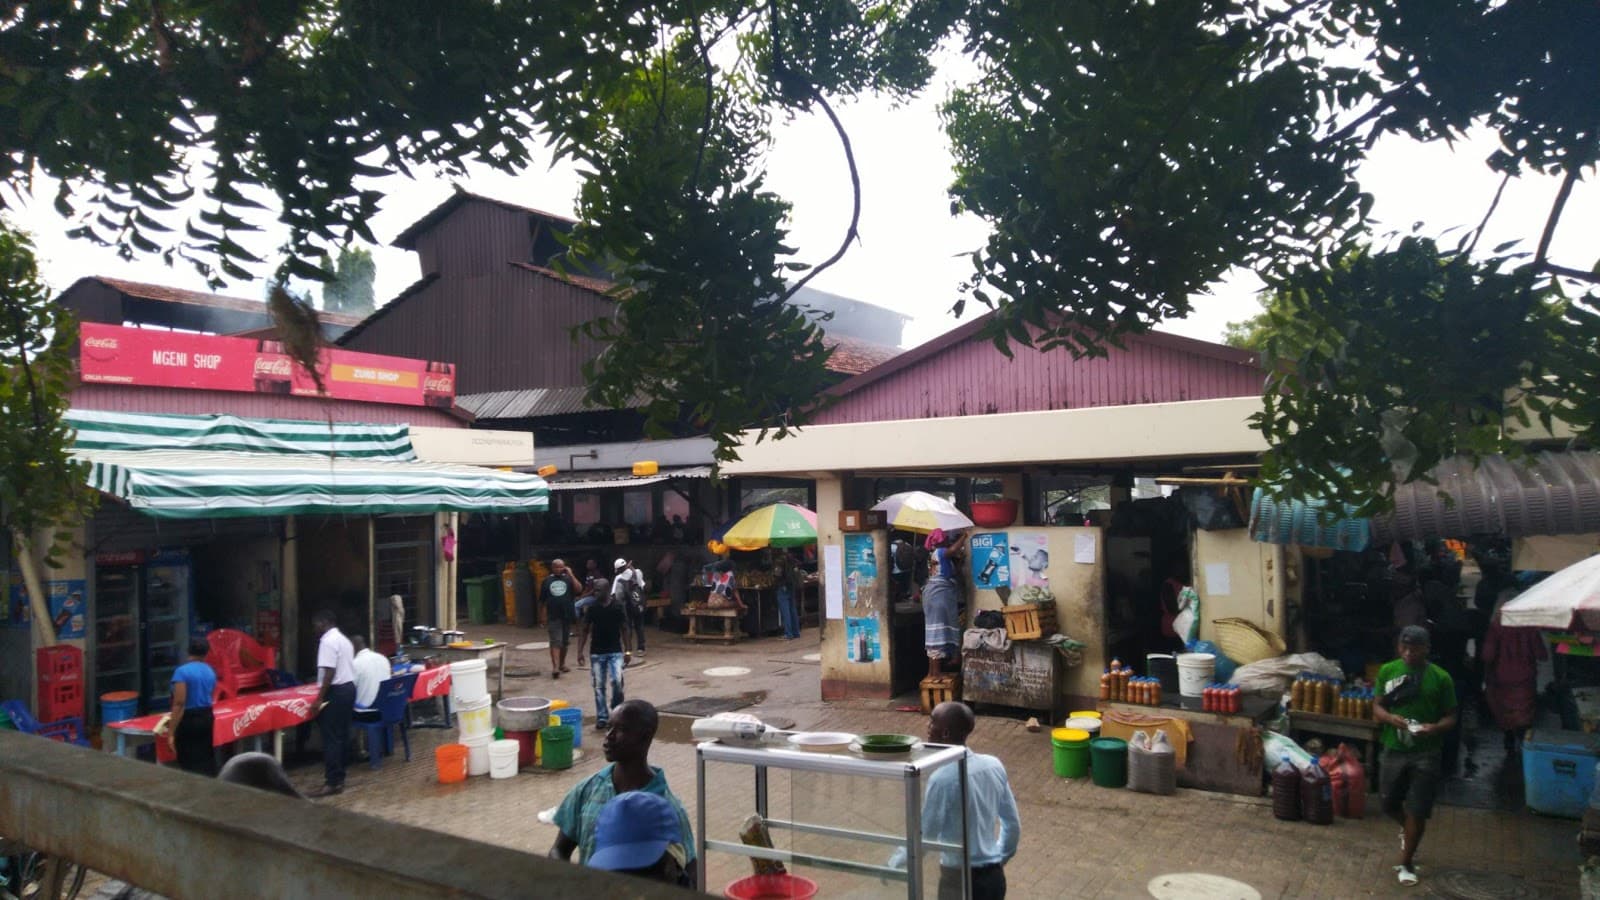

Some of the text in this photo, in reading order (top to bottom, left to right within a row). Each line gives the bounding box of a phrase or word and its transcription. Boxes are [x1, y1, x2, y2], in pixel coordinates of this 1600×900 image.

[152, 350, 222, 369] MGENI SHOP
[254, 357, 292, 378] Coca-Cola
[423, 375, 453, 395] Coca-Cola
[972, 537, 993, 547] BIGI
